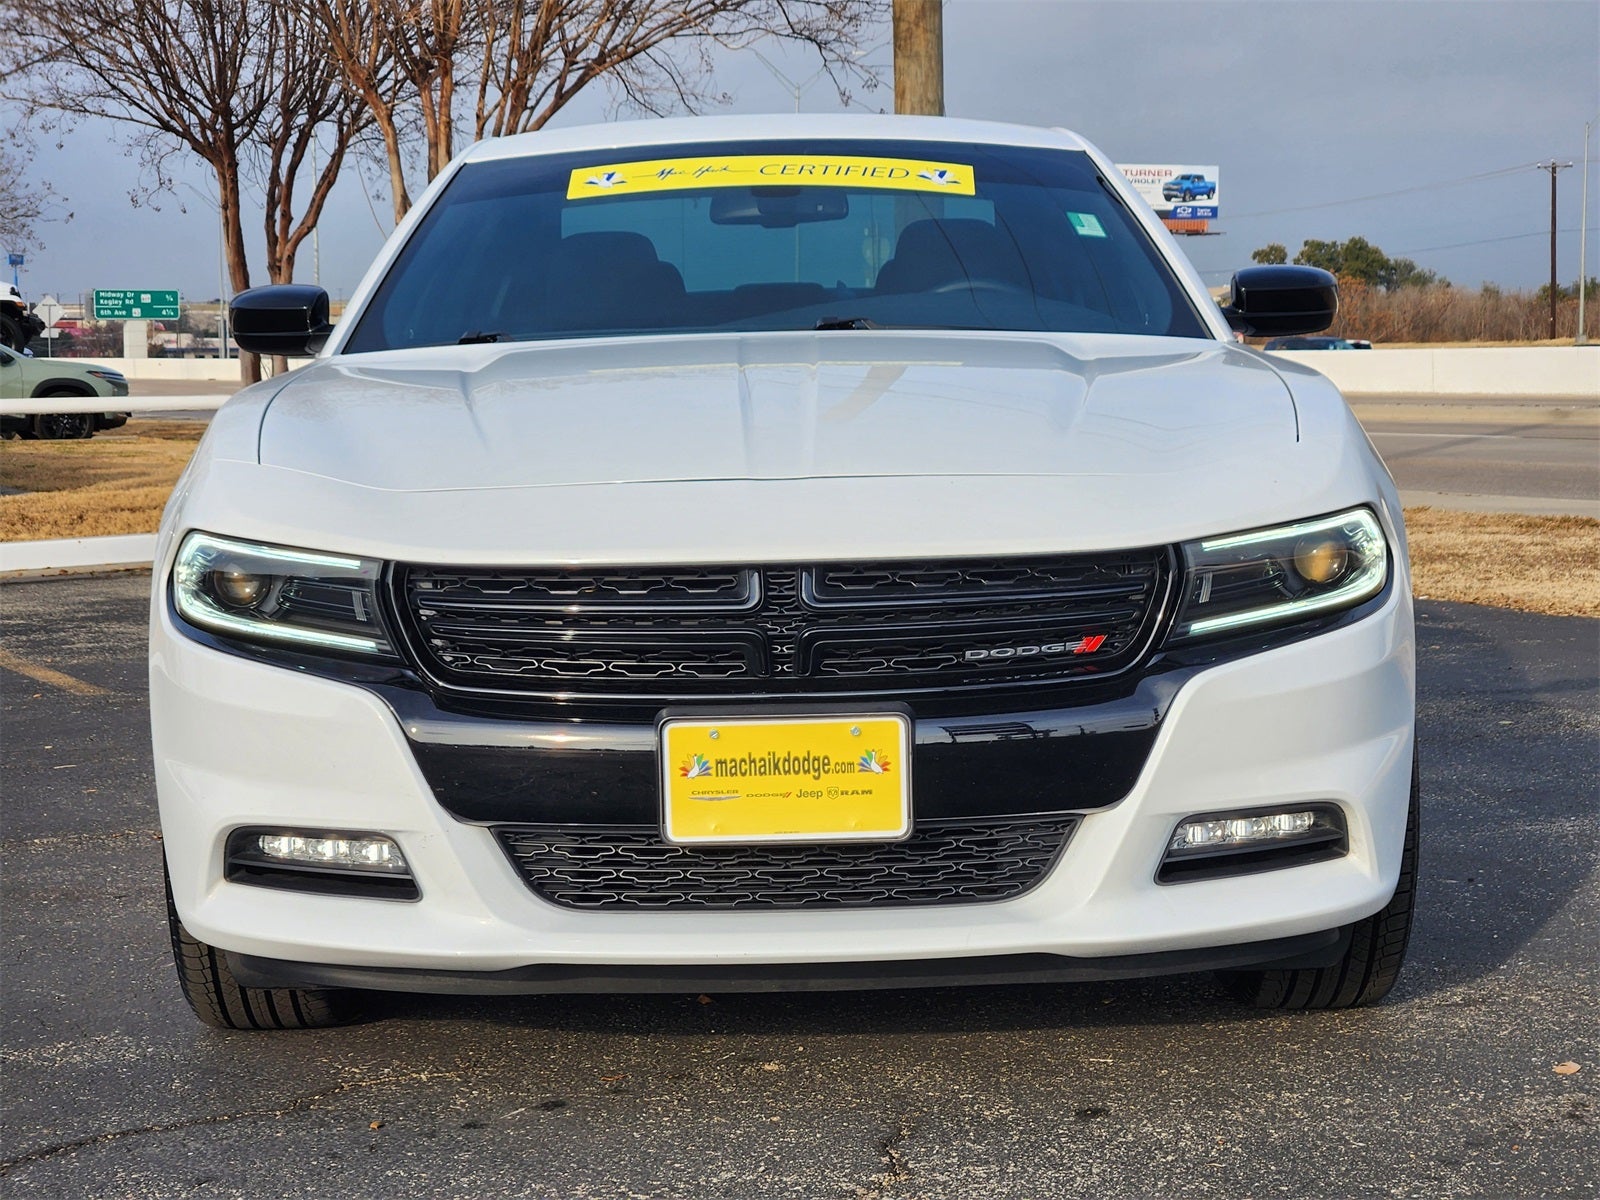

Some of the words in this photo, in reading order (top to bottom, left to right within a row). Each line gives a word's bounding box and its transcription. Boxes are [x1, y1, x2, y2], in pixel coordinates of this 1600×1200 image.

[759, 163, 910, 179] CERTIFIED
[1123, 169, 1173, 177] TURNER
[99, 291, 125, 299] Midway
[99, 298, 123, 306] Kegley
[965, 642, 1086, 661] DODGE
[714, 751, 856, 780] machaikdodge.com
[795, 788, 824, 800] Jeep
[840, 788, 873, 796] RAM
